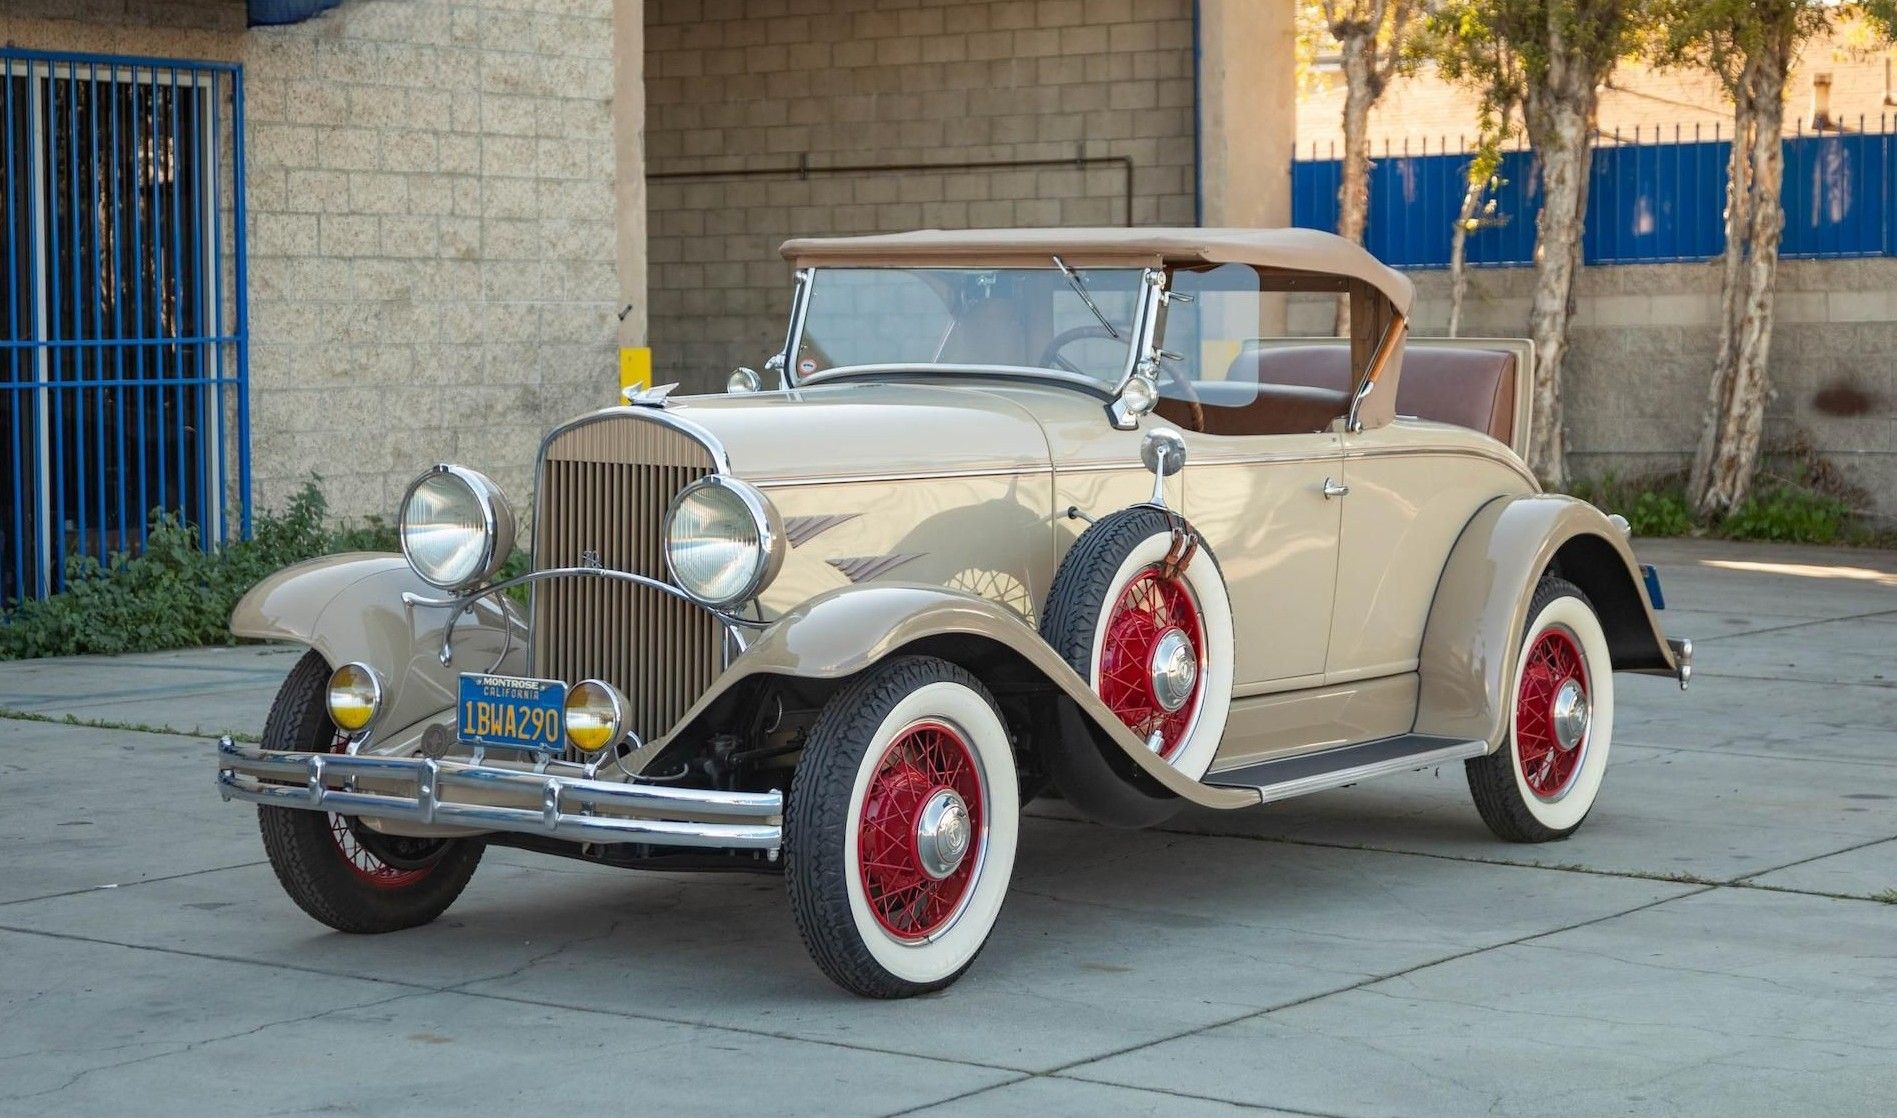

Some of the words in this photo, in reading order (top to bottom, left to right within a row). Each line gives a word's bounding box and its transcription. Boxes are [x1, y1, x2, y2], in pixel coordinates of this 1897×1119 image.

[483, 677, 540, 690] MONTROSE
[483, 686, 540, 700] CALIFORNIA
[463, 700, 559, 742] 1BWA290
